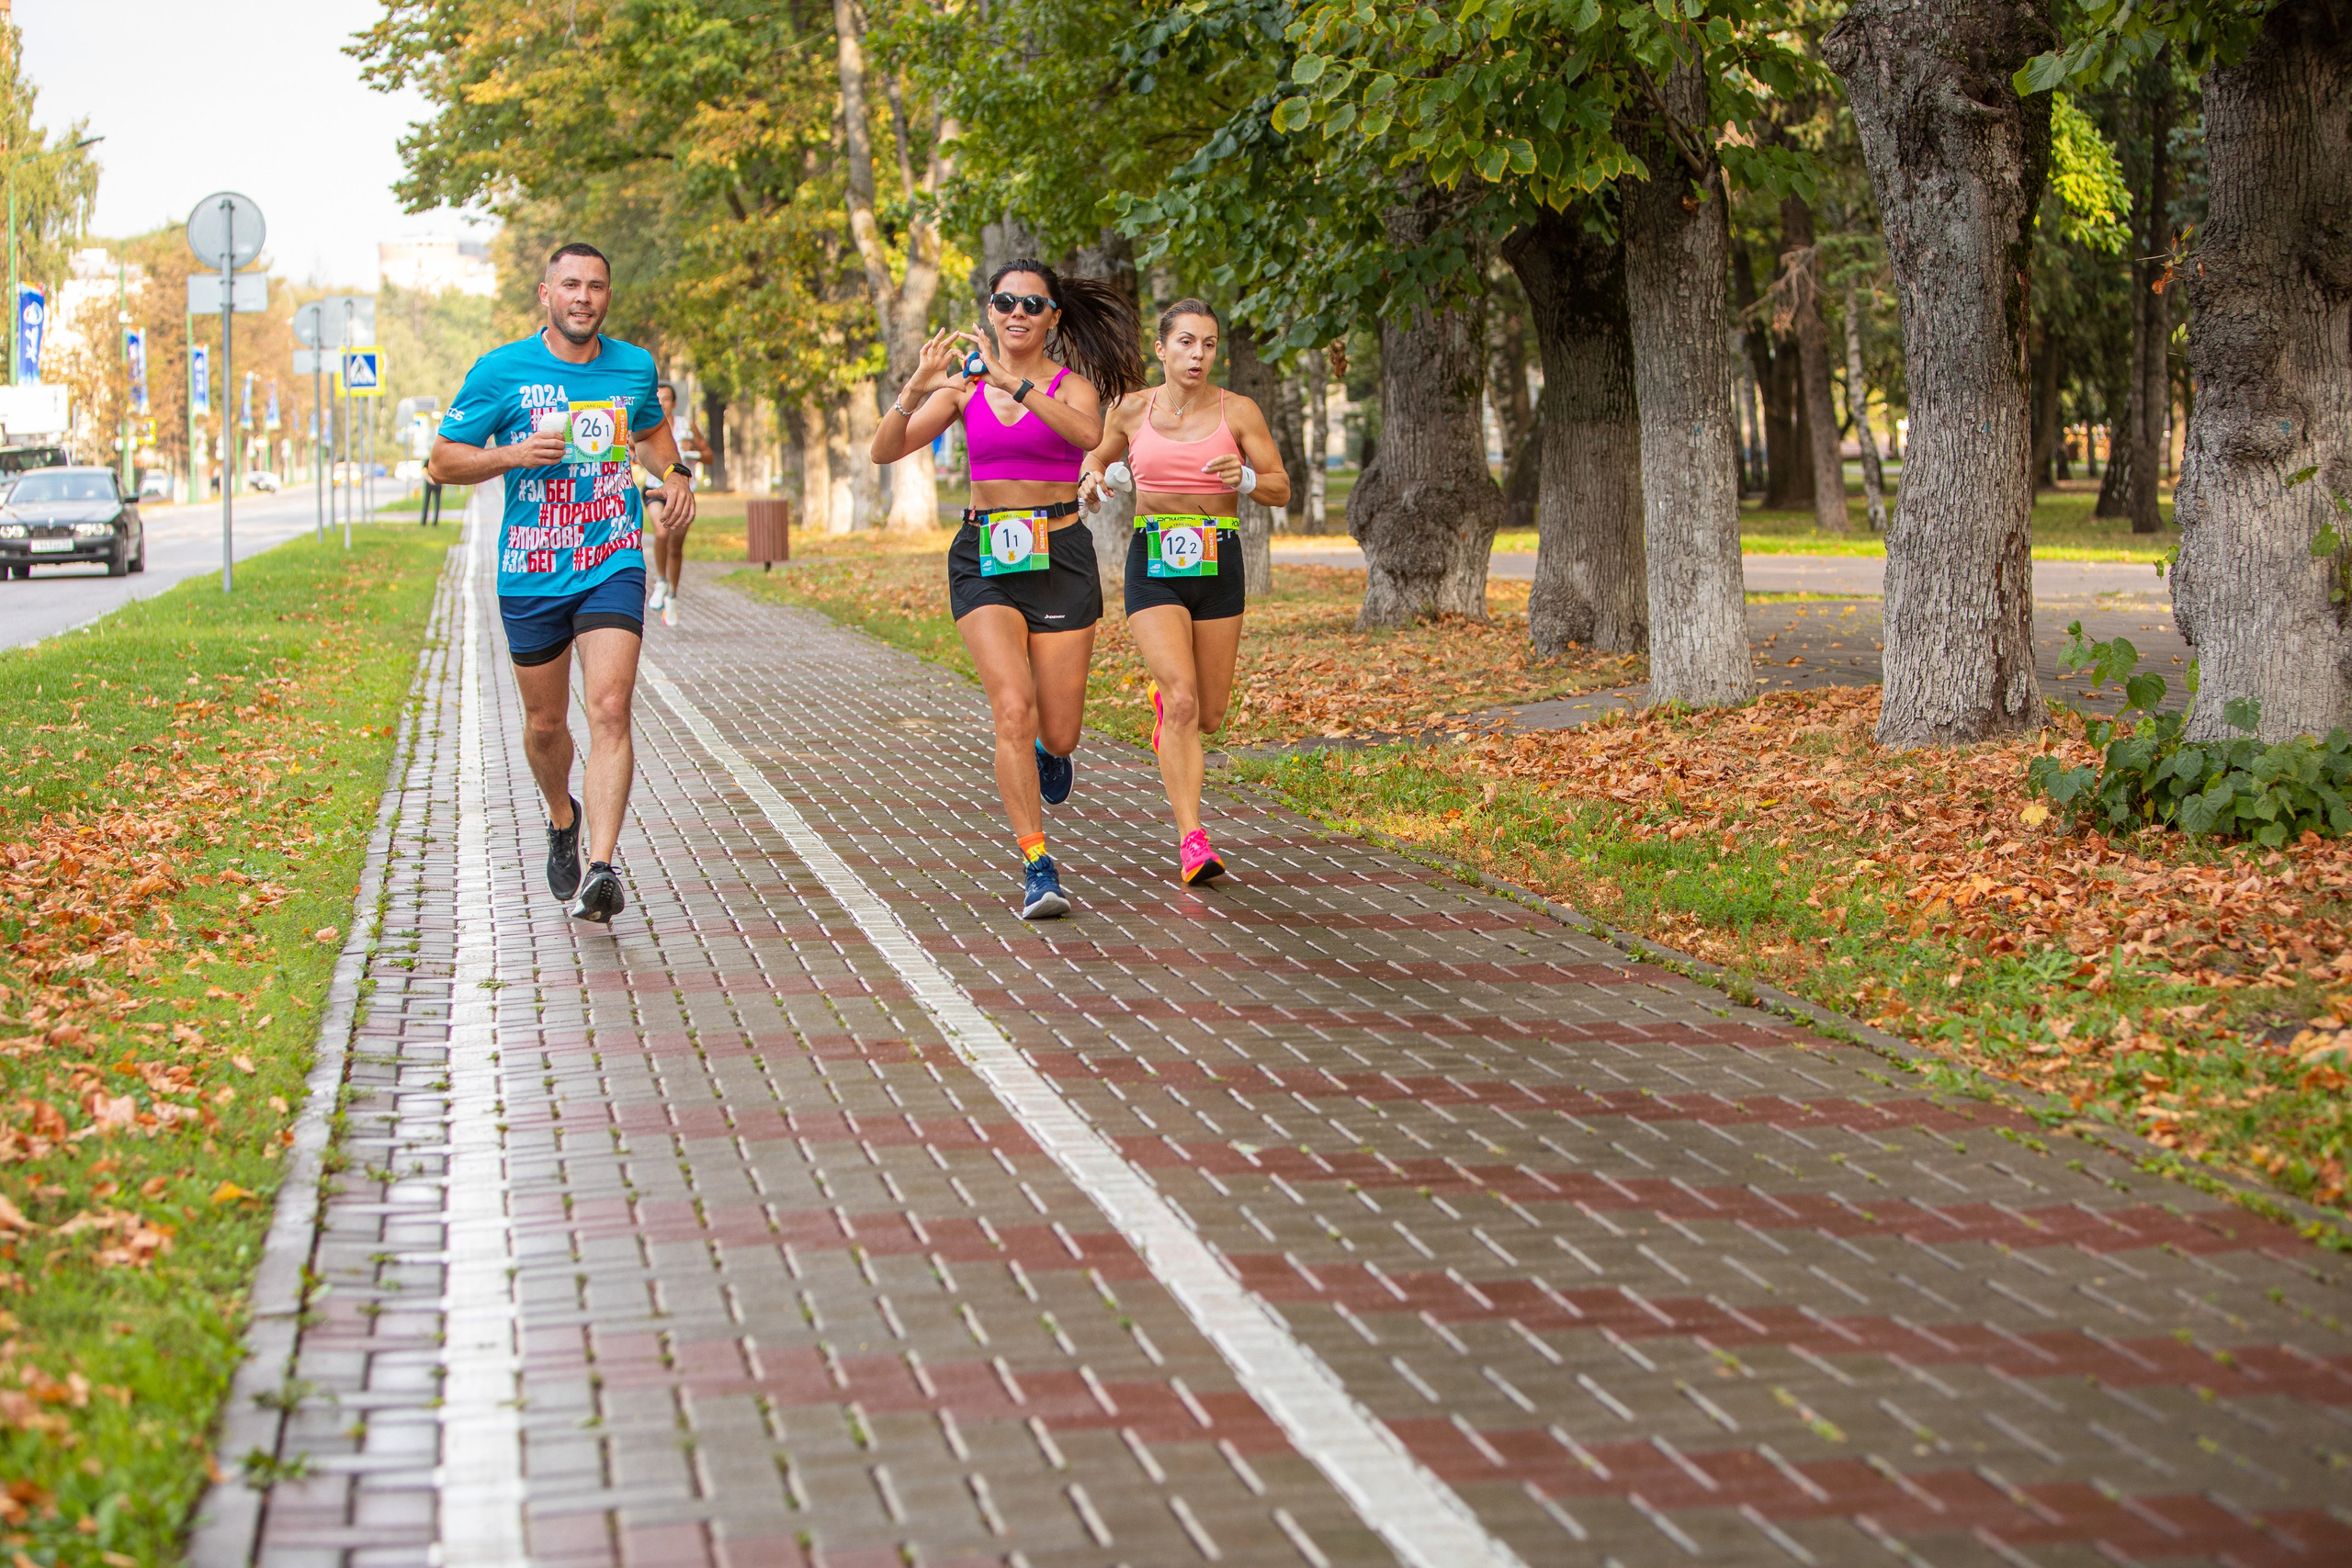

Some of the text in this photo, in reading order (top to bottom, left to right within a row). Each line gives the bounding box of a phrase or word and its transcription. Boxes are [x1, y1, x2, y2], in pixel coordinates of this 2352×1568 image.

[519, 384, 568, 409] 2024
[581, 417, 602, 438] 26
[518, 479, 576, 503] #ЗАБЕГ
[538, 491, 627, 527] #ГОРДОСТЬ
[508, 525, 585, 550] #ЛЮБОВЬ
[1166, 536, 1186, 555] 12
[1190, 542, 1197, 554] 2
[502, 549, 556, 573] #ЗАБЕГ
